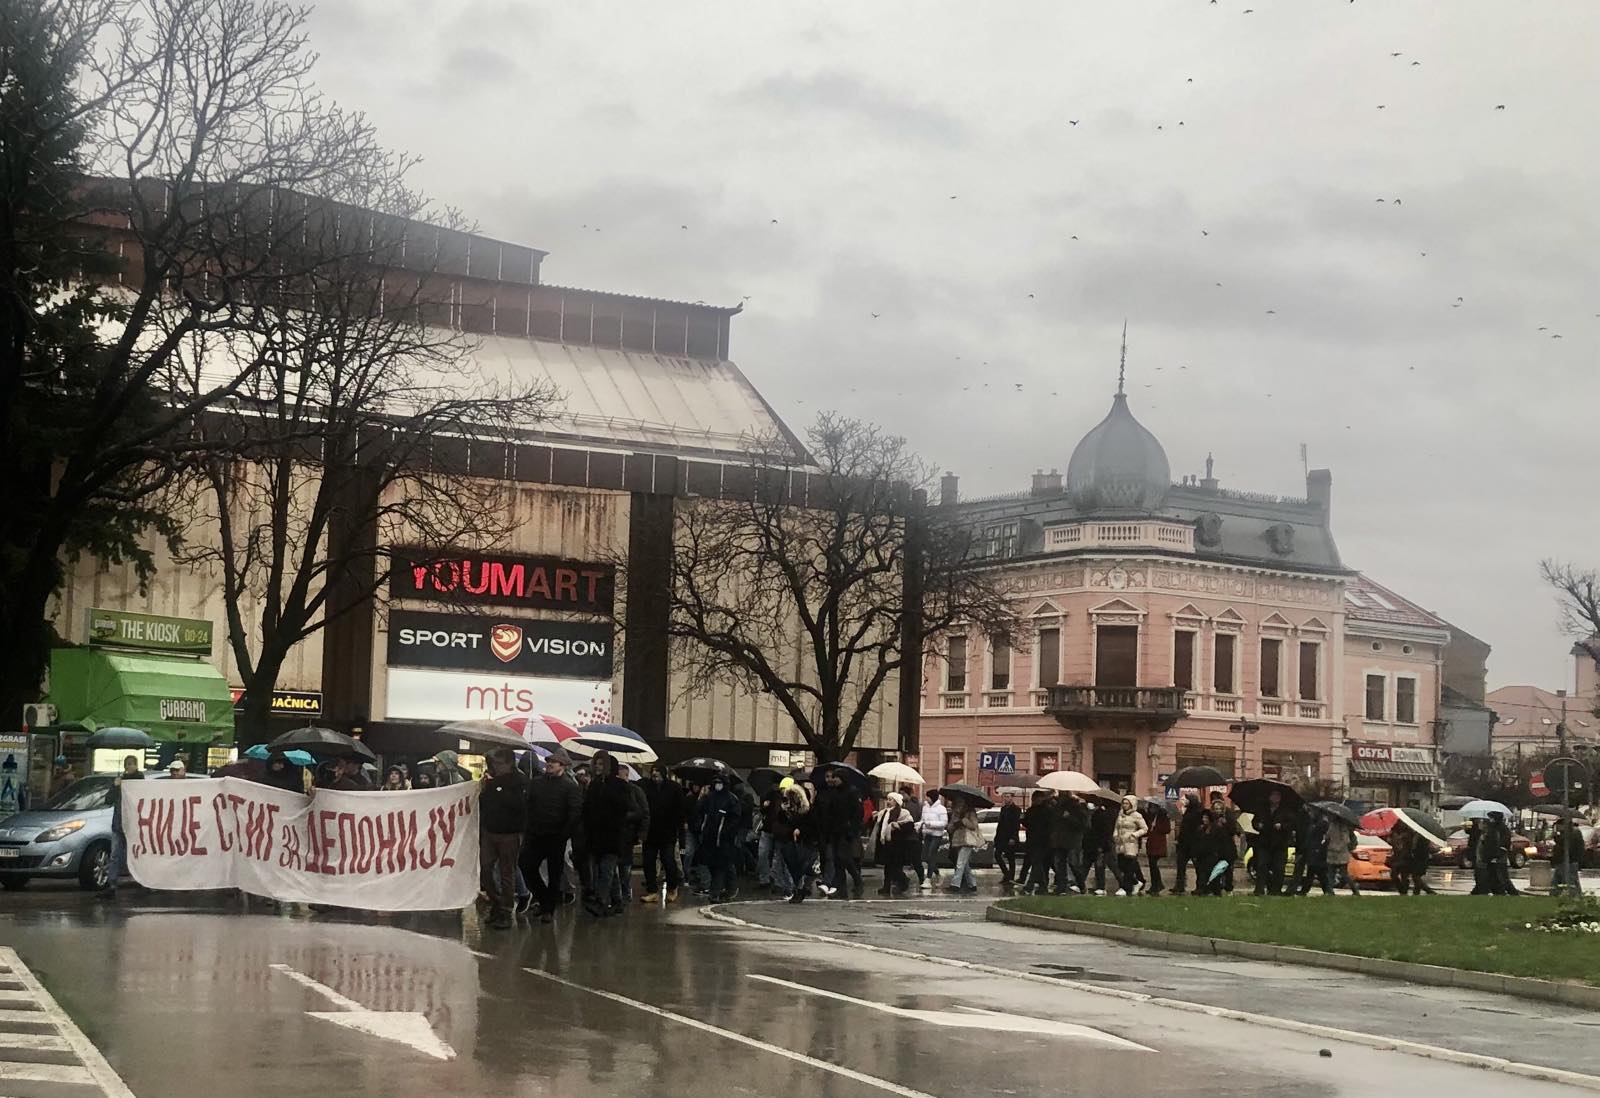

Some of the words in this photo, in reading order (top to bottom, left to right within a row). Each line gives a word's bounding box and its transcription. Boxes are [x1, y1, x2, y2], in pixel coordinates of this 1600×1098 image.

[410, 559, 604, 603] YOUMART
[120, 619, 144, 640] THE
[145, 621, 181, 643] KIOSK
[398, 628, 483, 649] SPORT
[527, 636, 606, 657] VISION
[465, 682, 534, 712] mts
[982, 755, 992, 768] P
[212, 793, 280, 861] СТИГ
[279, 823, 302, 871] ЗА
